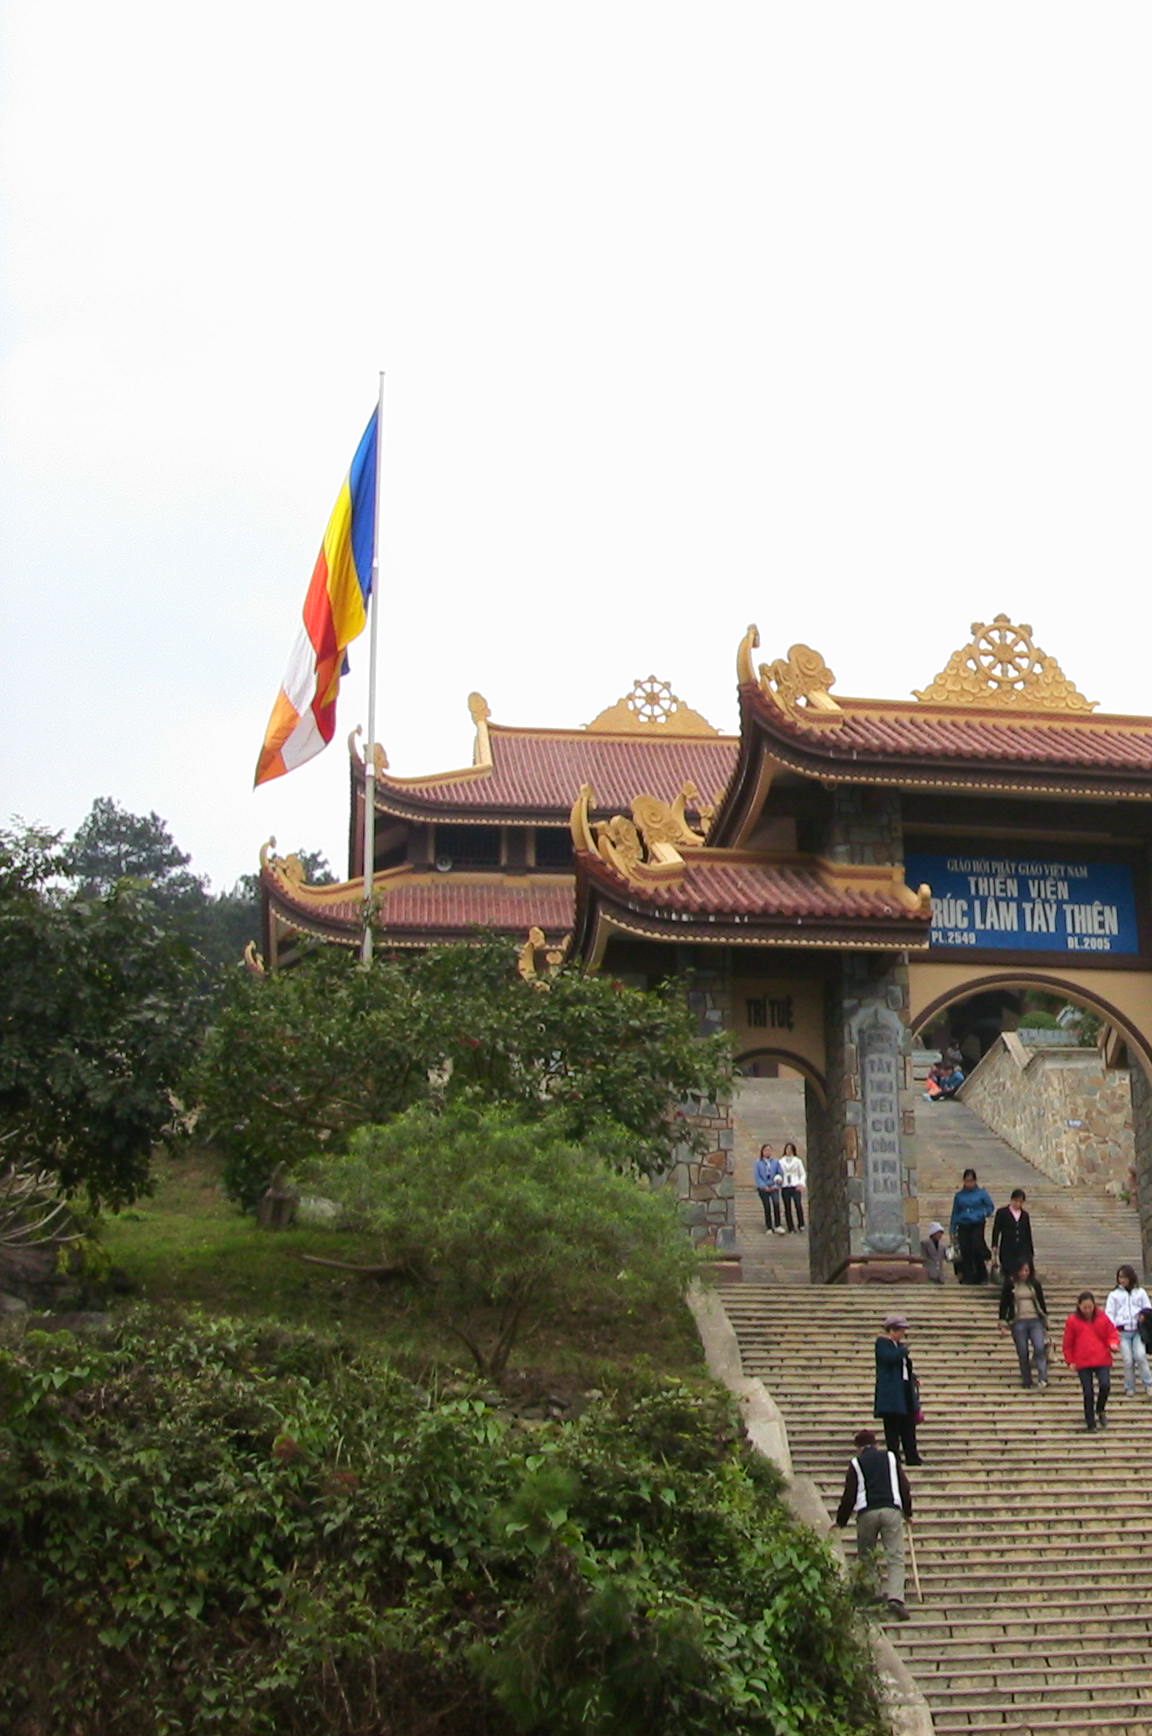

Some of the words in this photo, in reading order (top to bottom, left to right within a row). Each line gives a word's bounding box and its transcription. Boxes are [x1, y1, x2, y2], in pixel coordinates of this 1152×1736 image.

[946, 858, 971, 873] GIÁO
[1066, 865, 1088, 879] NAM
[930, 893, 969, 929] RÚC
[974, 896, 1018, 932] LÂM
[1022, 899, 1057, 933] TÂY
[1063, 900, 1118, 936] THIÊN
[931, 931, 977, 945] PL.2549
